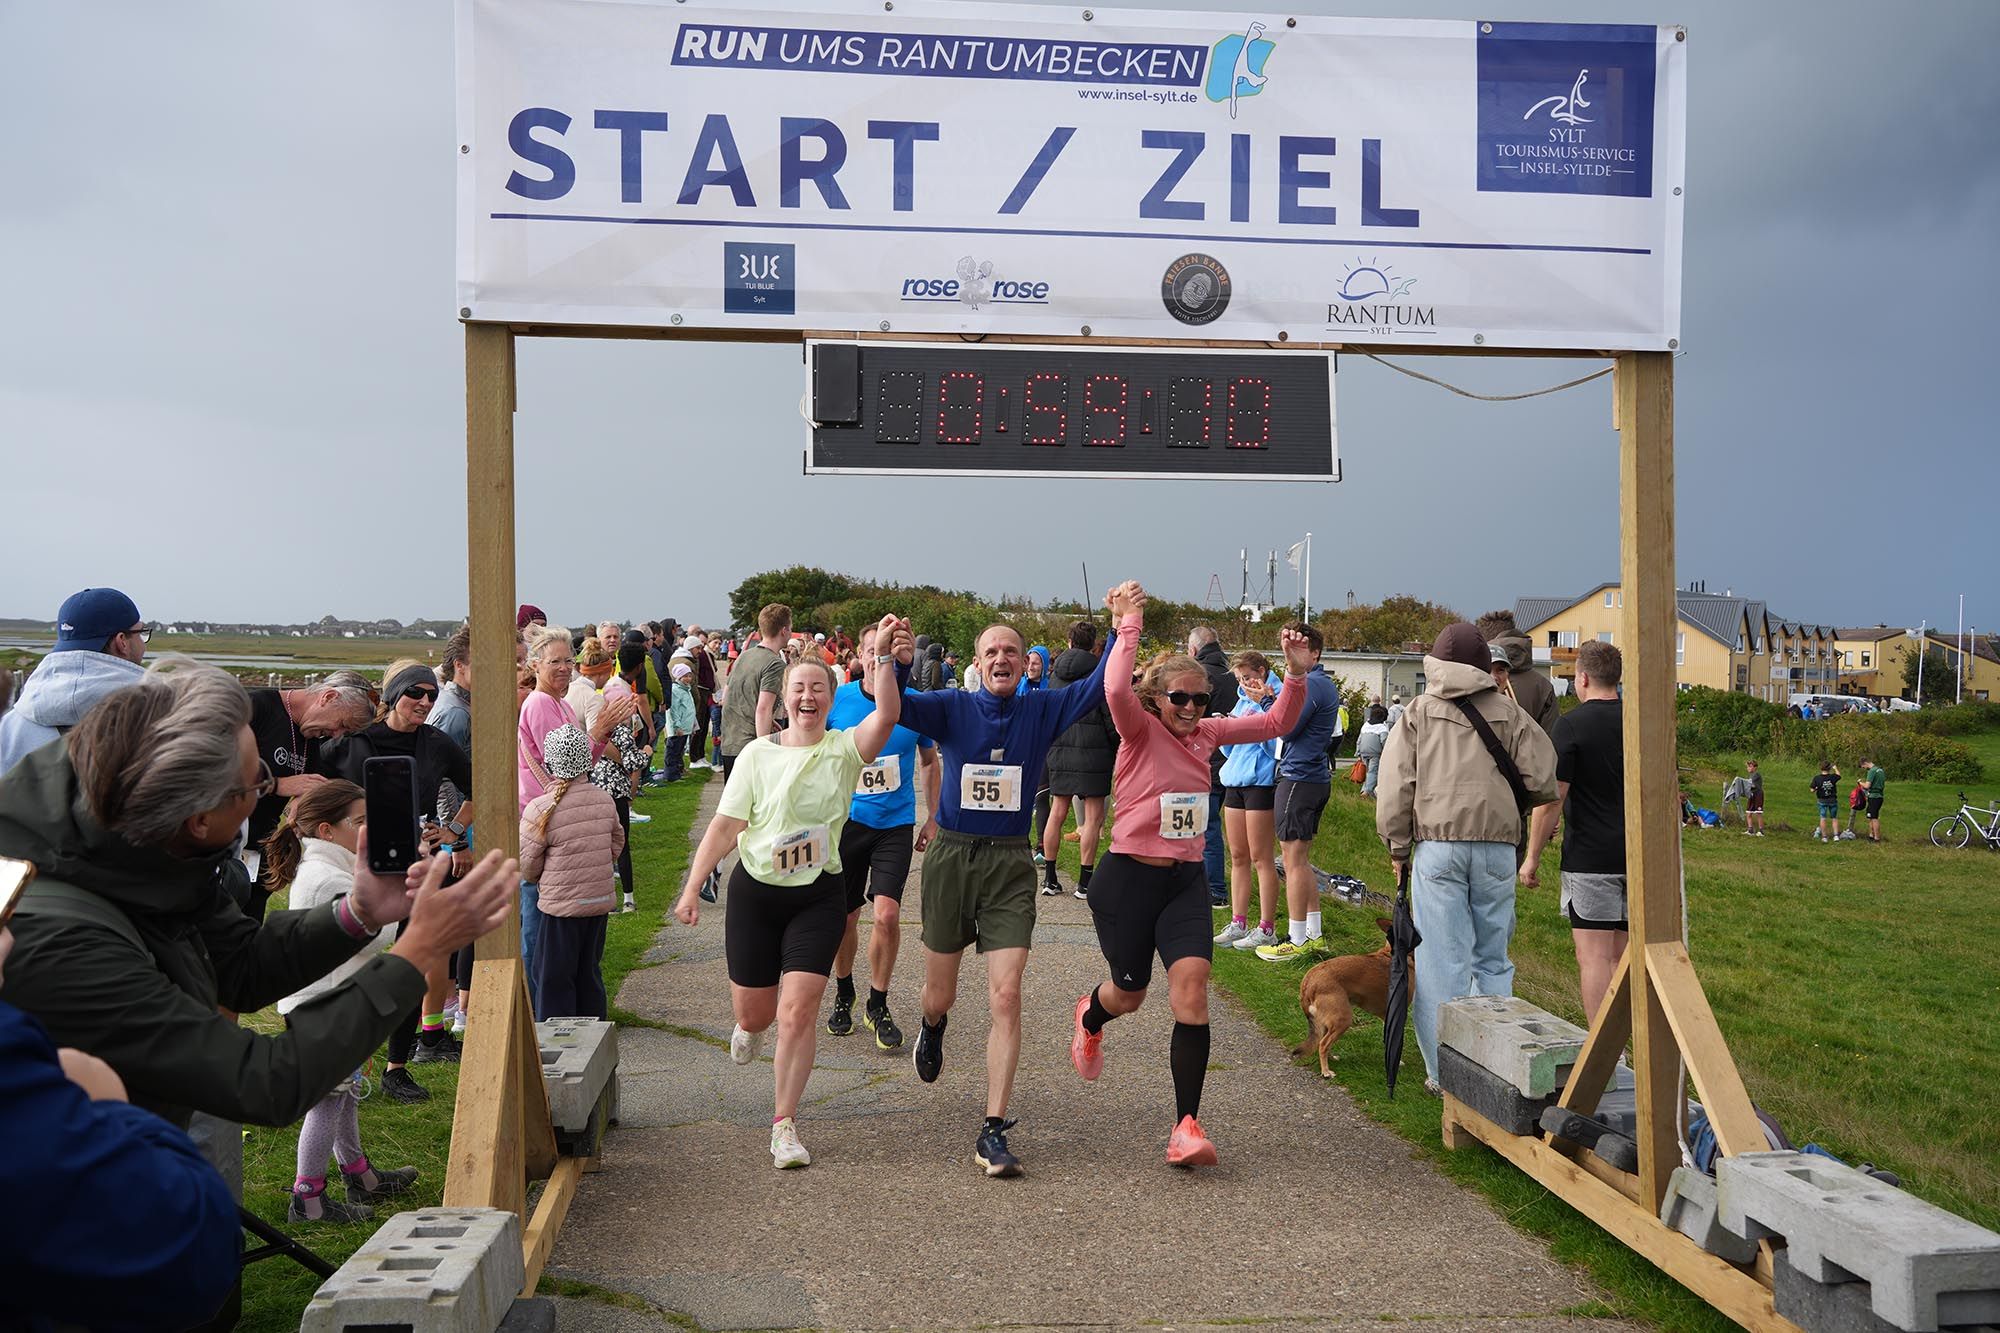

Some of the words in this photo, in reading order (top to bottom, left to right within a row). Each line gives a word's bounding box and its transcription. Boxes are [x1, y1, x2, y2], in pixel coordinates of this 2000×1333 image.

[680, 29, 768, 61] RUN
[779, 33, 866, 66] UMS
[877, 37, 1199, 80] RANTUMBECKEN
[1078, 87, 1198, 104] www.insel-sylt.de
[1549, 127, 1586, 144] SYLT
[1496, 144, 1635, 162] TOURISMUS-SERVICE
[505, 107, 940, 212] START
[997, 126, 1078, 215] /
[1139, 129, 1420, 228] ZIEL
[1520, 162, 1612, 177] INSEL-SYLT.DE
[1165, 255, 1199, 285] FRIESEN
[1202, 256, 1229, 287] BANDE
[745, 282, 757, 290] TUI
[757, 282, 776, 290] BLUE
[902, 278, 960, 297] rose
[992, 280, 1049, 299] rose
[753, 295, 766, 304] Sylt
[1327, 303, 1436, 326] RANTUM
[1370, 326, 1393, 336] SYLT
[862, 770, 886, 788] 64
[972, 780, 1000, 802] 55
[1172, 809, 1194, 830] 54
[778, 842, 812, 869] 111
